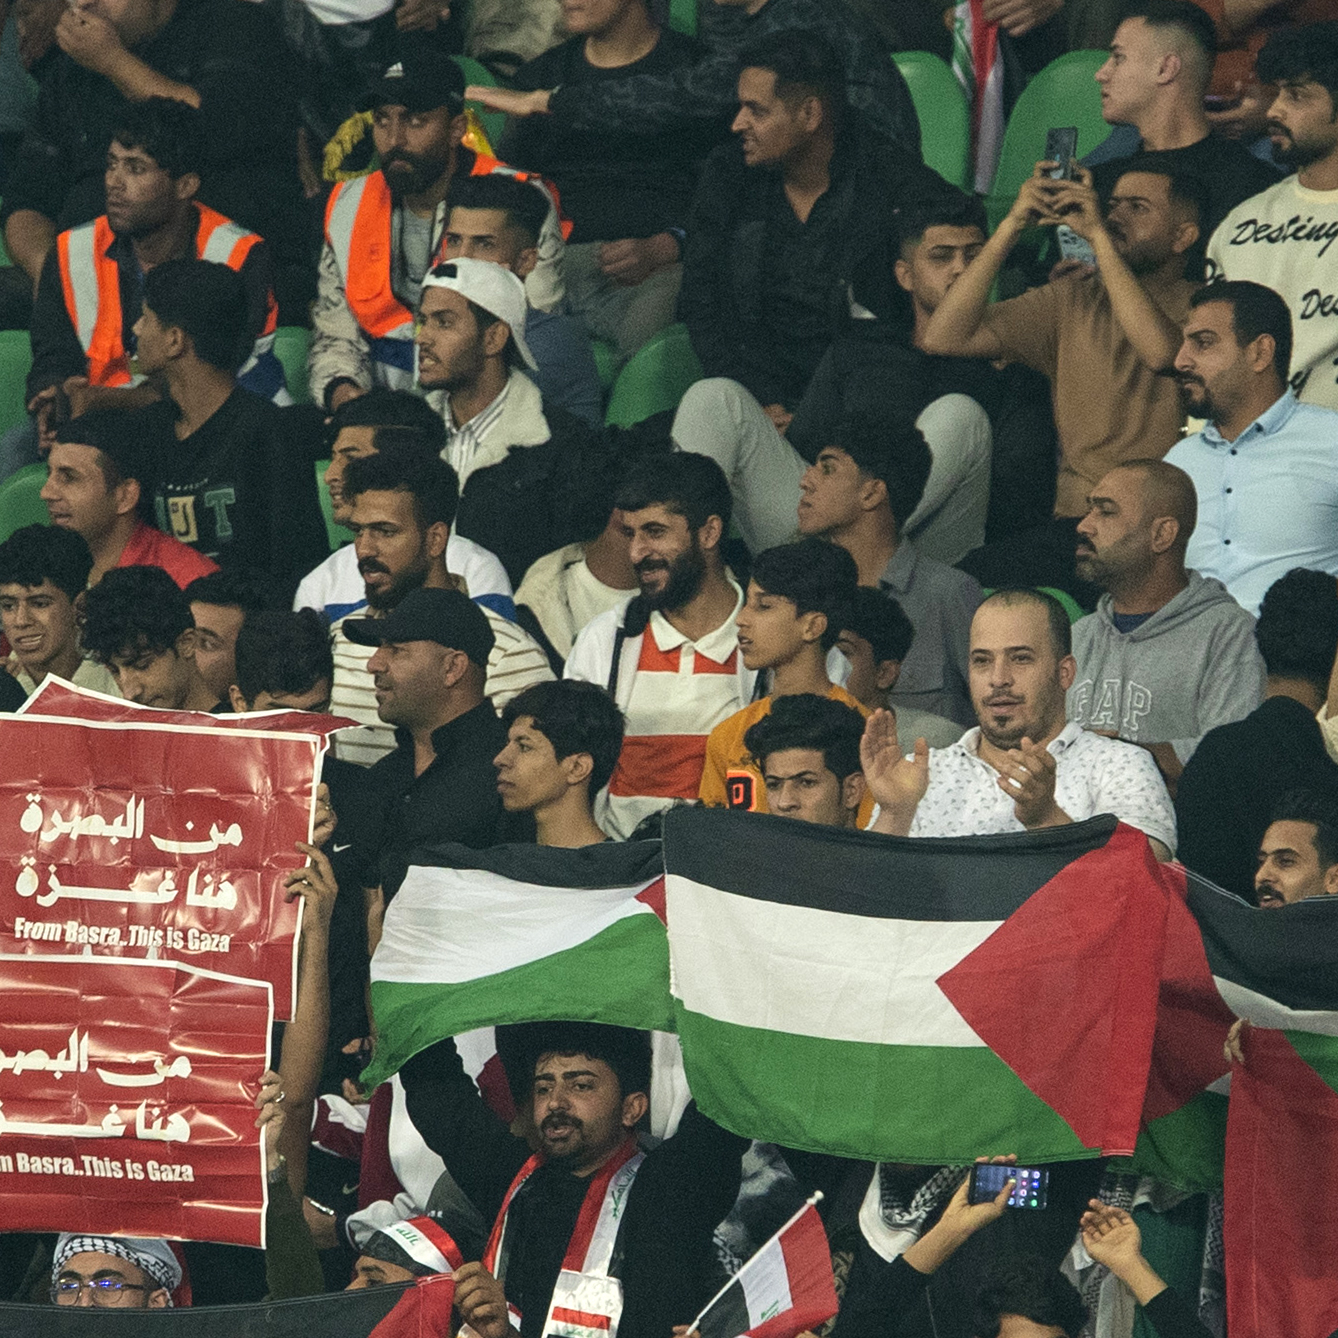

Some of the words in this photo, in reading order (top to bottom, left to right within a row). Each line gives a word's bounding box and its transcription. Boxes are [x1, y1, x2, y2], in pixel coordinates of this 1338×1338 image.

[20, 792, 144, 846] البصرة
[150, 820, 243, 854] من
[186, 862, 238, 911] هنا
[14, 916, 61, 941] From
[167, 926, 183, 949] is
[187, 927, 231, 953] Gaza
[96, 1055, 193, 1088] من
[135, 1099, 191, 1143] هنا
[125, 1158, 144, 1180] is
[146, 1160, 195, 1183] Gaza
